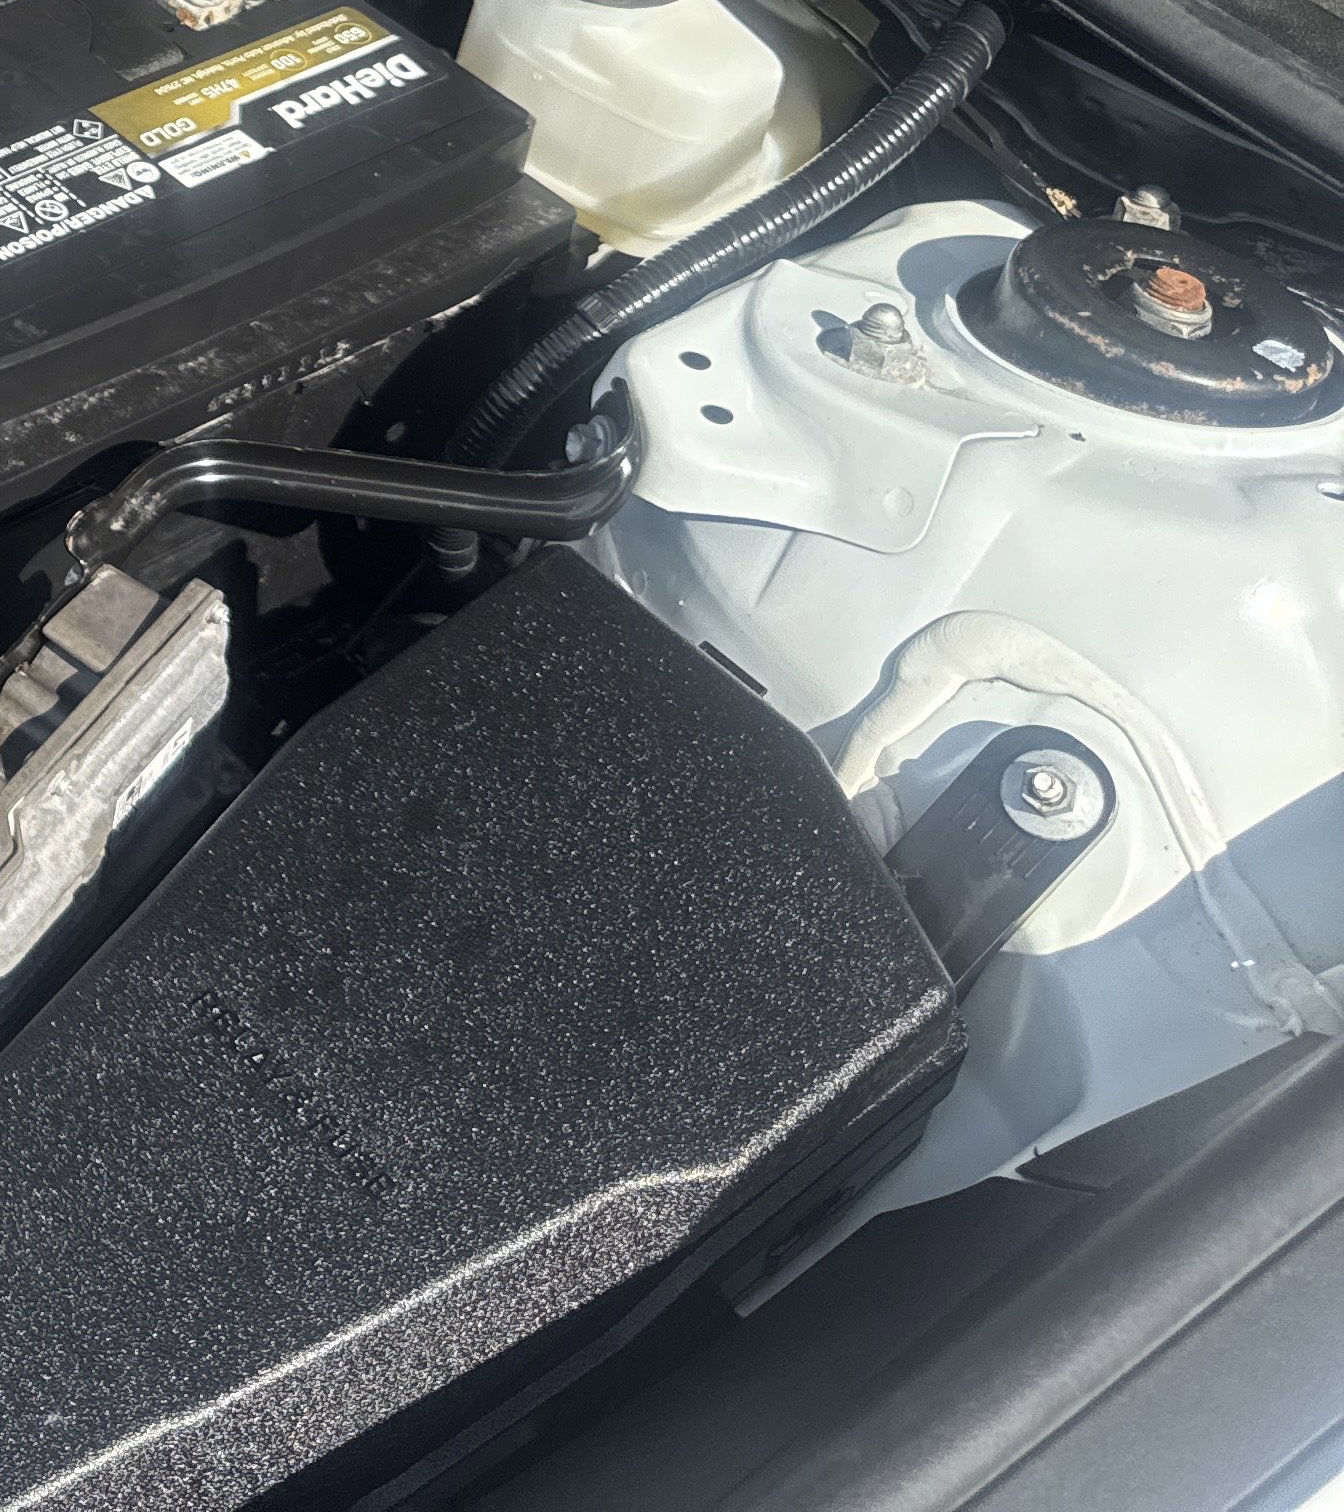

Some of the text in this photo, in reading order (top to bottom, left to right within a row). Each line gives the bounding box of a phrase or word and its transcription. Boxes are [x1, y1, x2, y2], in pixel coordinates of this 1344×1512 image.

[332, 25, 367, 45] 650
[268, 51, 302, 71] 100
[198, 76, 243, 100] 47H5
[269, 51, 429, 130] DieHard
[137, 115, 198, 148] GOLD
